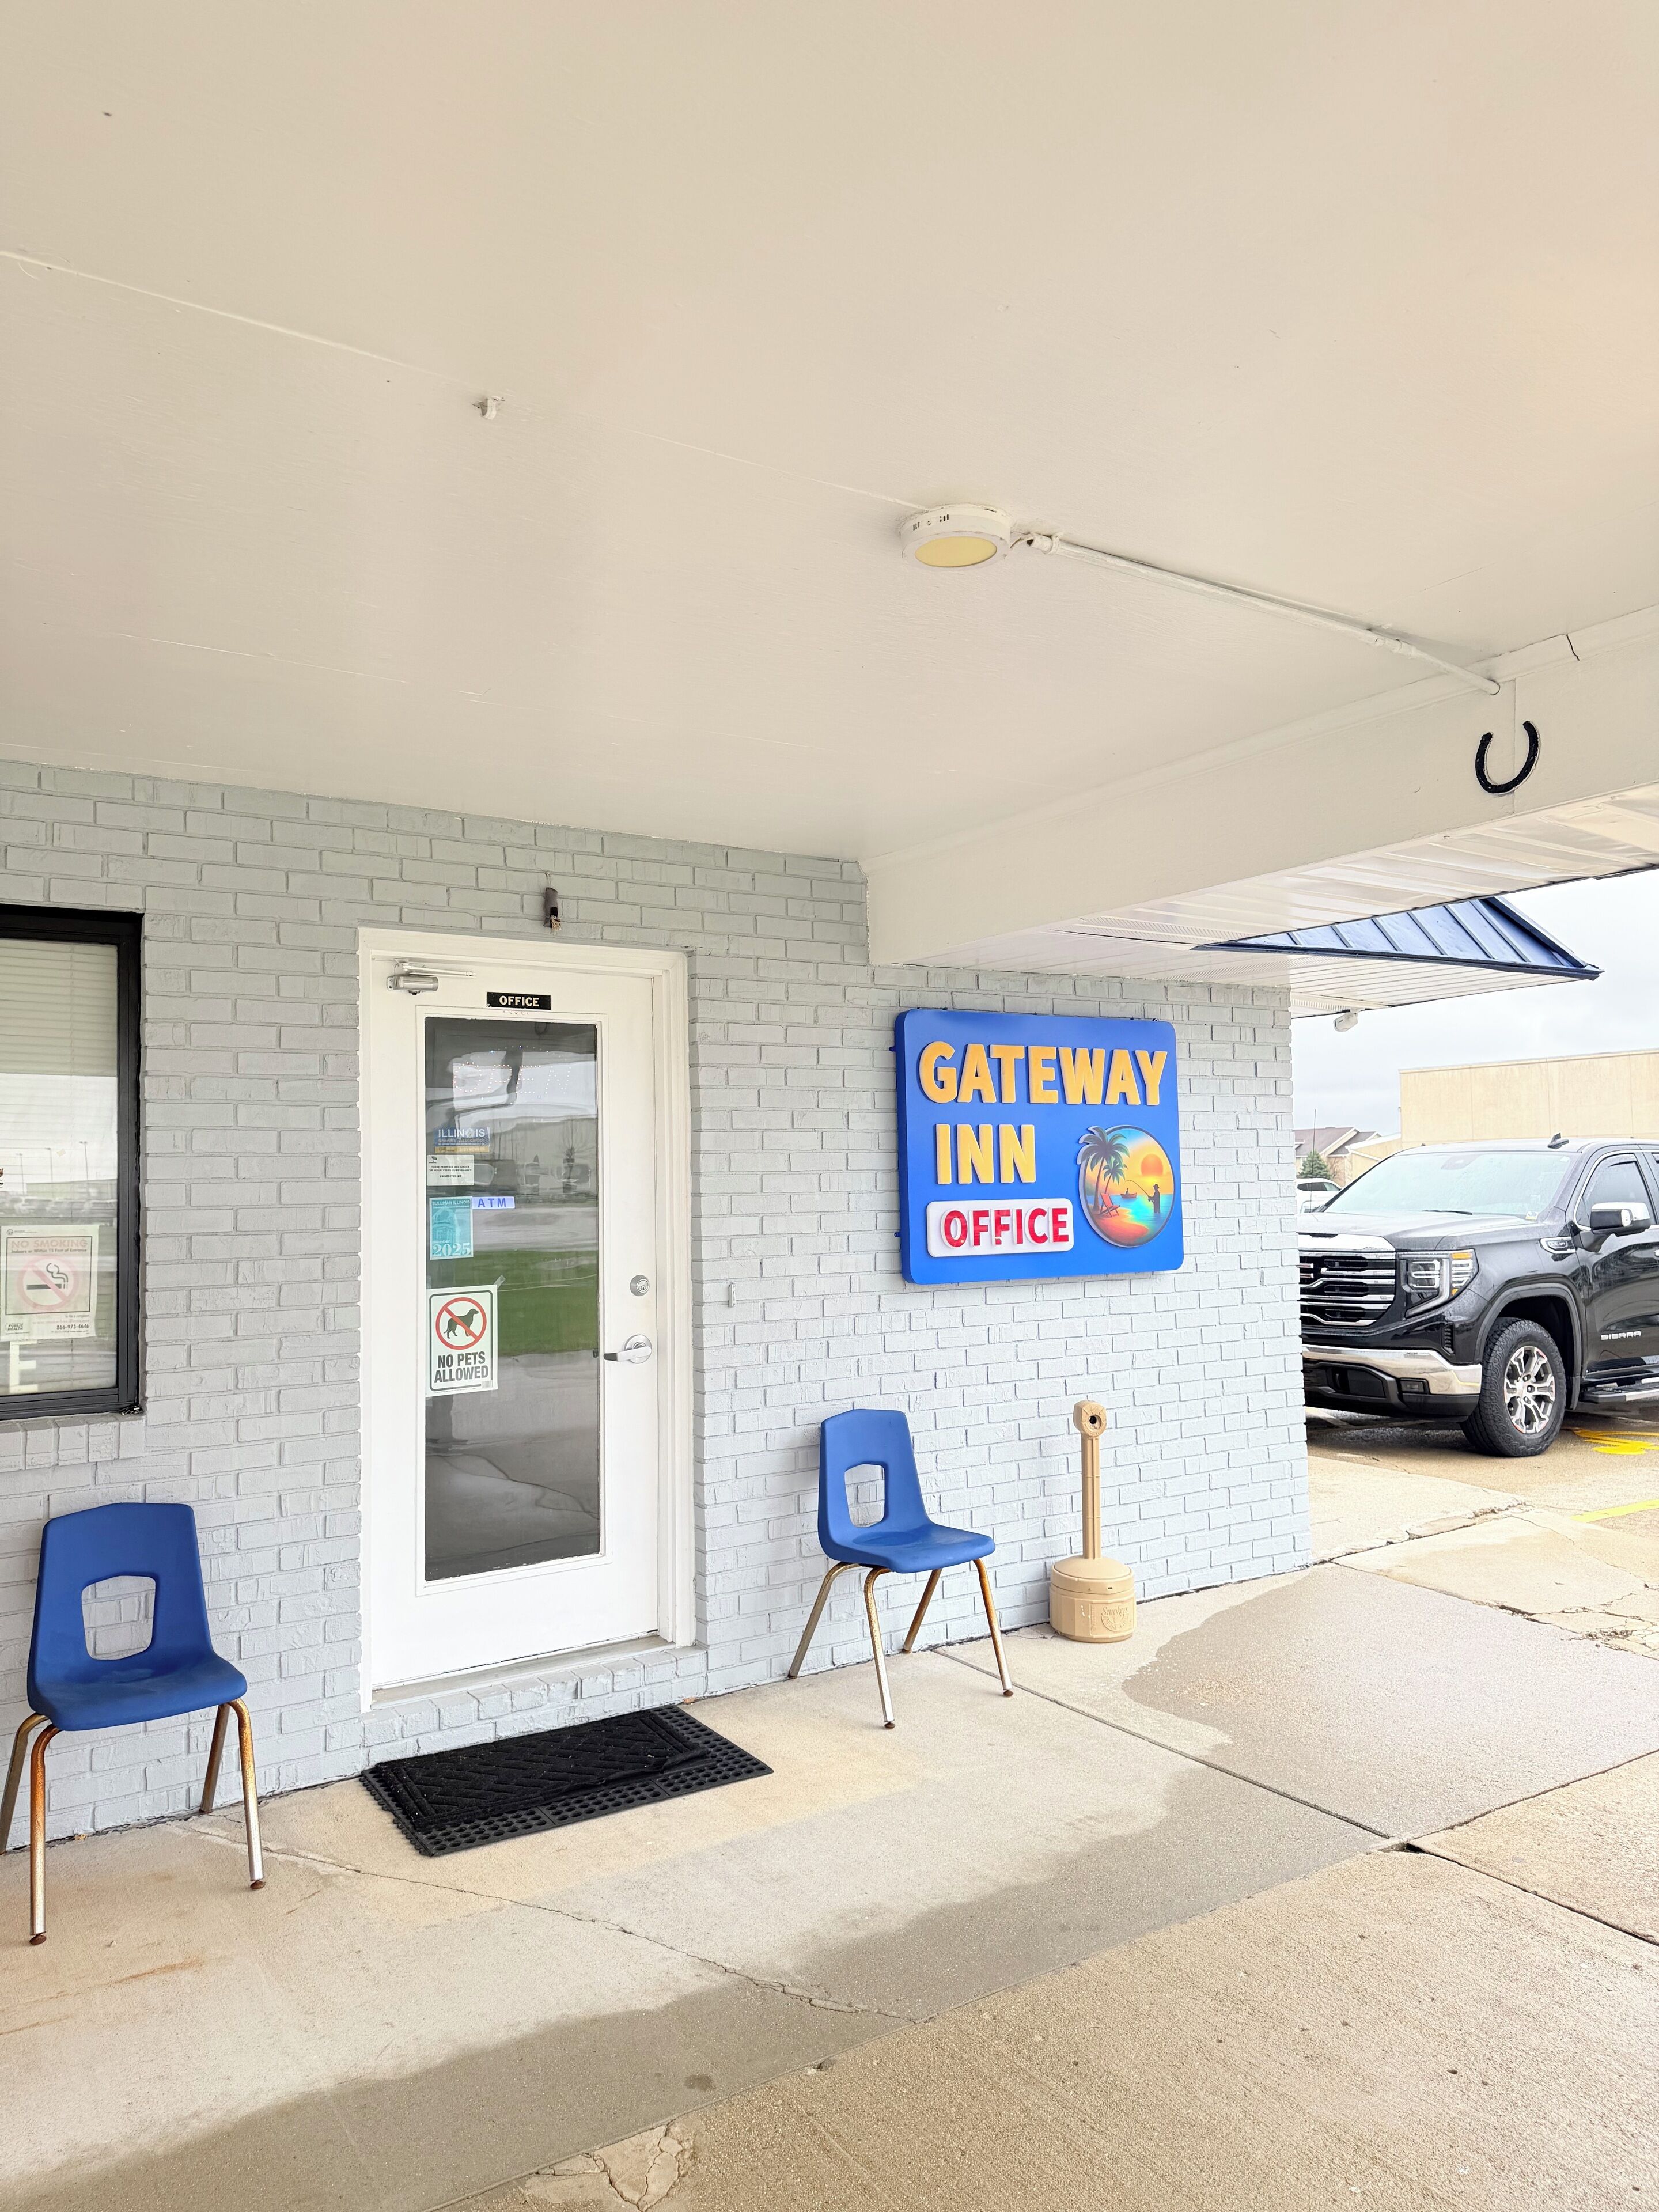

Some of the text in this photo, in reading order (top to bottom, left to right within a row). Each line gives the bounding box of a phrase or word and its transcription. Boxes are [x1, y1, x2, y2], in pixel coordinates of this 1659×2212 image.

[499, 995, 540, 1007] OFFICE
[453, 1062, 571, 1094] OPEN
[919, 1041, 1168, 1105] GATEWAY
[935, 1123, 1036, 1185] INN
[478, 1198, 506, 1208] ATM
[942, 1207, 1070, 1248] OFFICE
[11, 1238, 88, 1248] NO SMOKING
[433, 1242, 471, 1257] 2025
[1601, 1331, 1642, 1340] SIERRA
[437, 1351, 486, 1369] NO PETS
[434, 1365, 488, 1384] ALLOWED
